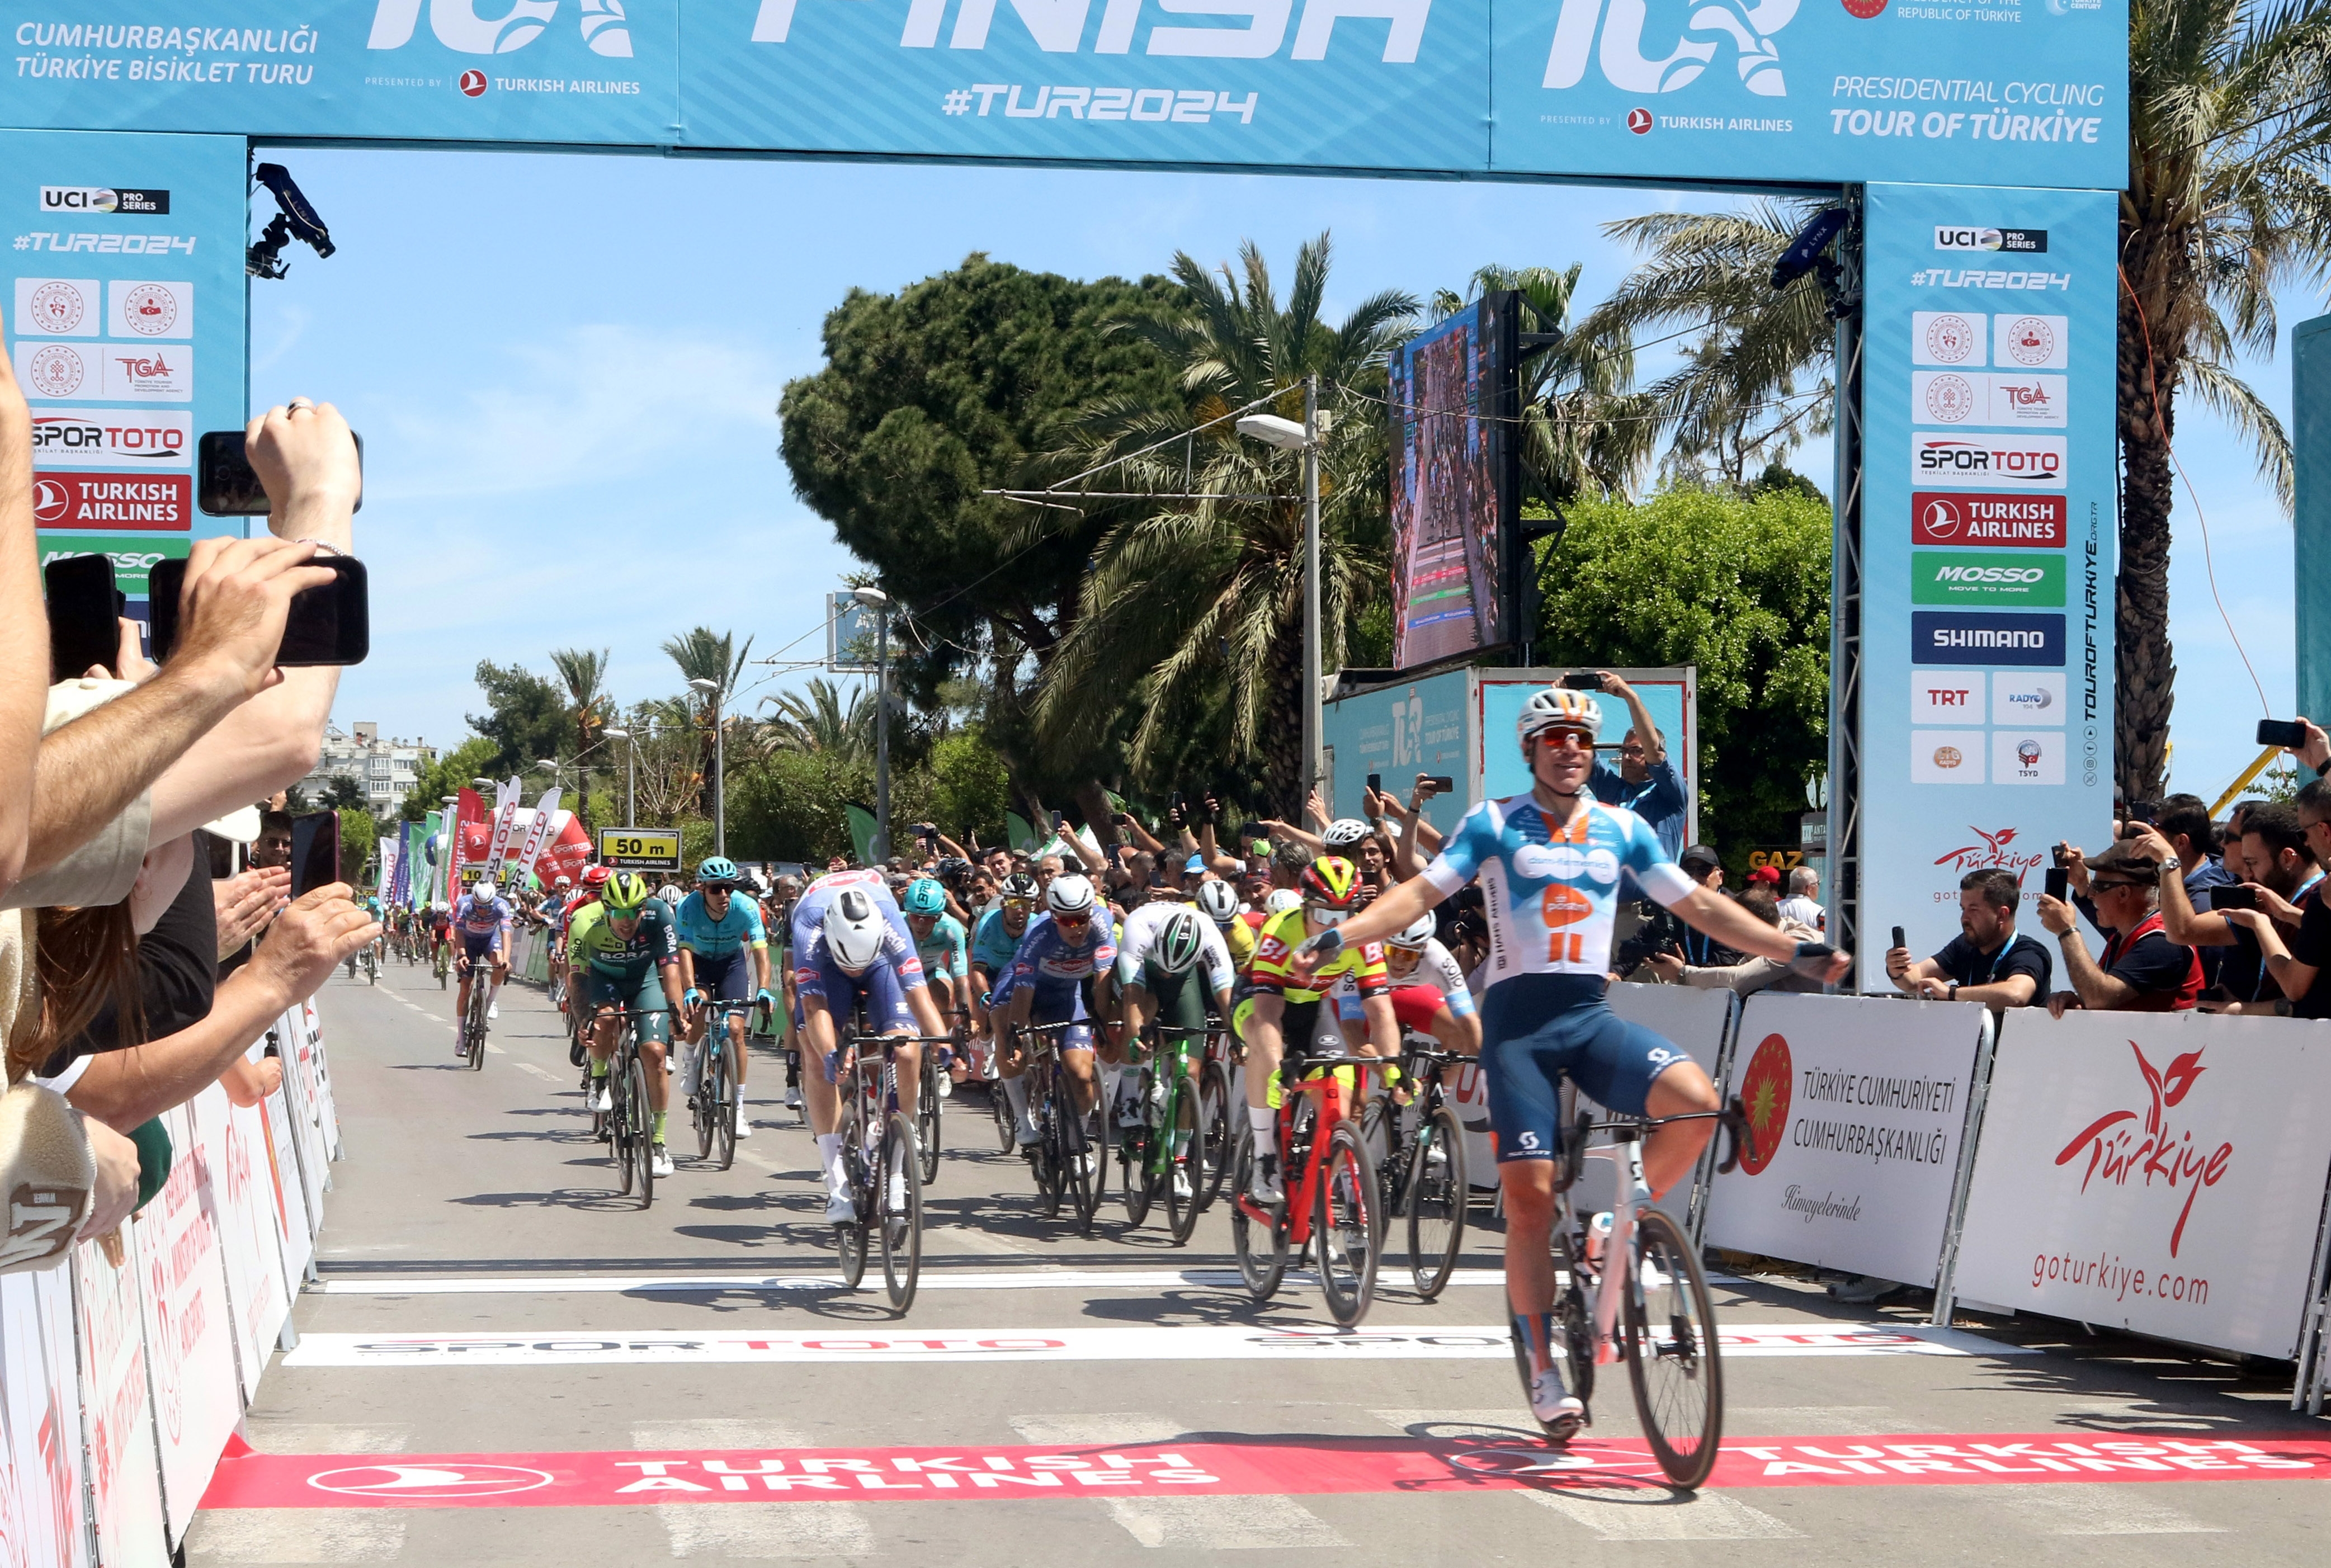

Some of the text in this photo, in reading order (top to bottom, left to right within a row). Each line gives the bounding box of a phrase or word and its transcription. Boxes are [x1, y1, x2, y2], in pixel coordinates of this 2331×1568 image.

[1898, 7, 2022, 22] REPUBLIC OF TÜRKİYE
[16, 22, 318, 56] CUMHURBAŞKANLIĞI
[16, 52, 314, 84] TÜRKİYE BİSİKLET TURU
[365, 77, 442, 87] PRESENTED BY
[495, 78, 640, 95] TURKISH AIRLINES
[1832, 75, 2104, 106] PRESIDENTIAL CYCLING
[942, 83, 1258, 124] #TUR2024
[1541, 115, 1611, 125] PRESENTED BY
[1660, 116, 1793, 132] TURKISH AIRLINES
[1830, 107, 2102, 143] TOUR OF TÜRKİYE
[45, 191, 87, 207] UCI
[122, 192, 144, 201] PRO
[122, 201, 157, 210] SERIES
[13, 232, 196, 255] #TUR2024
[1809, 226, 1828, 246] LYNX
[1939, 230, 1976, 247] UCI
[2006, 240, 2036, 249] SERIES
[2007, 232, 2025, 240] PRO
[1910, 268, 2070, 291] #TUR2024
[115, 352, 174, 383] TGA
[1999, 381, 2051, 410] TGA
[79, 483, 177, 501] TURKISH
[77, 503, 178, 521] AIRLINES
[1968, 502, 2054, 519] TURKISH
[1966, 521, 2055, 539] AIRLINES
[1934, 566, 2045, 583] MOSSO
[1933, 629, 2045, 649] SHIMANO
[1928, 689, 1969, 706] TRT
[616, 839, 664, 854] 50 m
[1749, 851, 1804, 870] GAZ
[1934, 846, 2043, 887] Türkiye
[663, 924, 677, 953] BORA
[600, 950, 650, 959] BORA
[1257, 938, 1286, 960] B!
[1802, 1065, 1956, 1114] TÜRKİYE CUMHURİYETİ
[1794, 1118, 1947, 1166] CUMHURBAŞKANLIĞI
[2054, 1109, 2233, 1258] Türkiye
[2032, 1250, 2210, 1305] goturkiye.com
[1719, 1439, 2242, 1462] TURKISH
[615, 1453, 1191, 1475] TURKISH
[1763, 1453, 2316, 1475] AIRLINES
[614, 1469, 1221, 1491] AIRLINES
